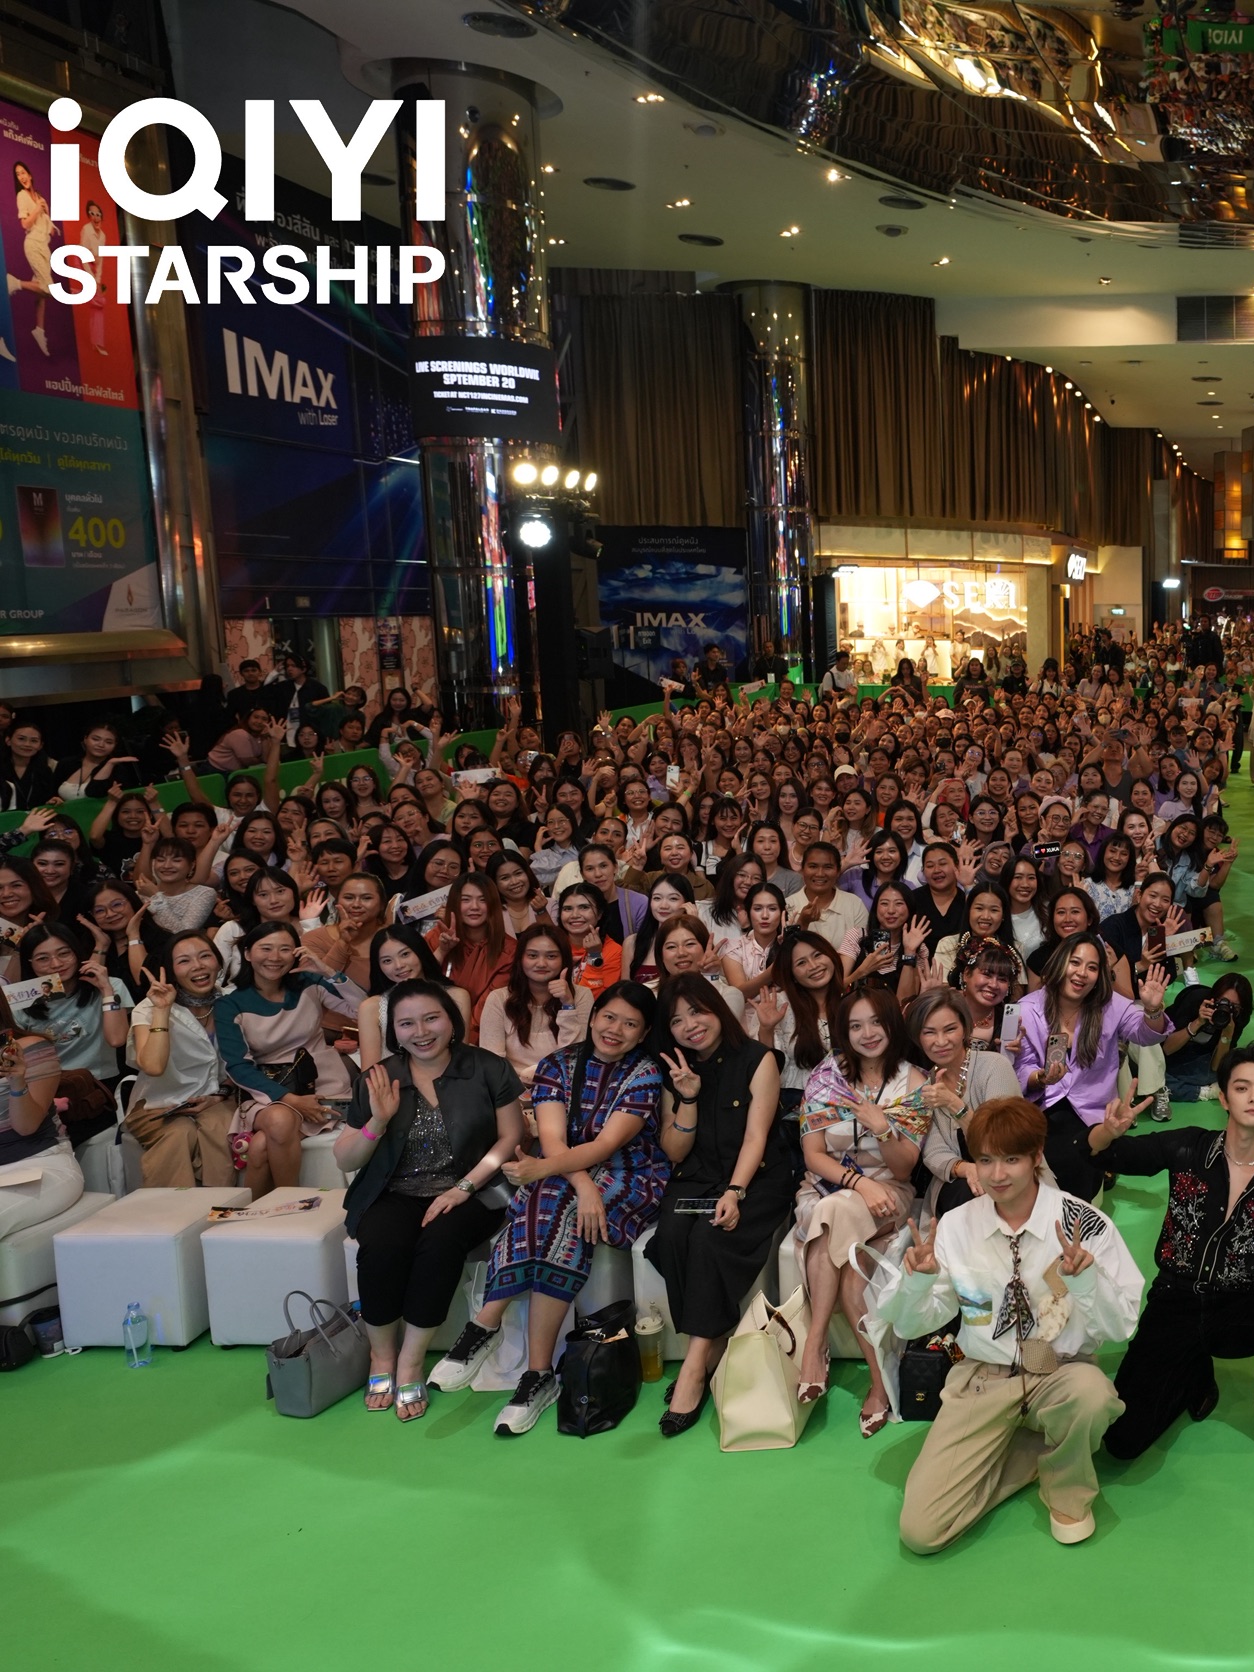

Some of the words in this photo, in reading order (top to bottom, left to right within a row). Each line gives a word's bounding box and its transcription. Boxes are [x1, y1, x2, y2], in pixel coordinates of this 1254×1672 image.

[223, 327, 339, 410] IMAX
[430, 360, 487, 374] SCRENINGS
[501, 377, 516, 389] 20
[297, 408, 318, 425] with
[319, 410, 339, 426] Laser
[68, 516, 126, 549] 400
[9, 610, 45, 619] GROUP
[635, 612, 708, 628] IMAX
